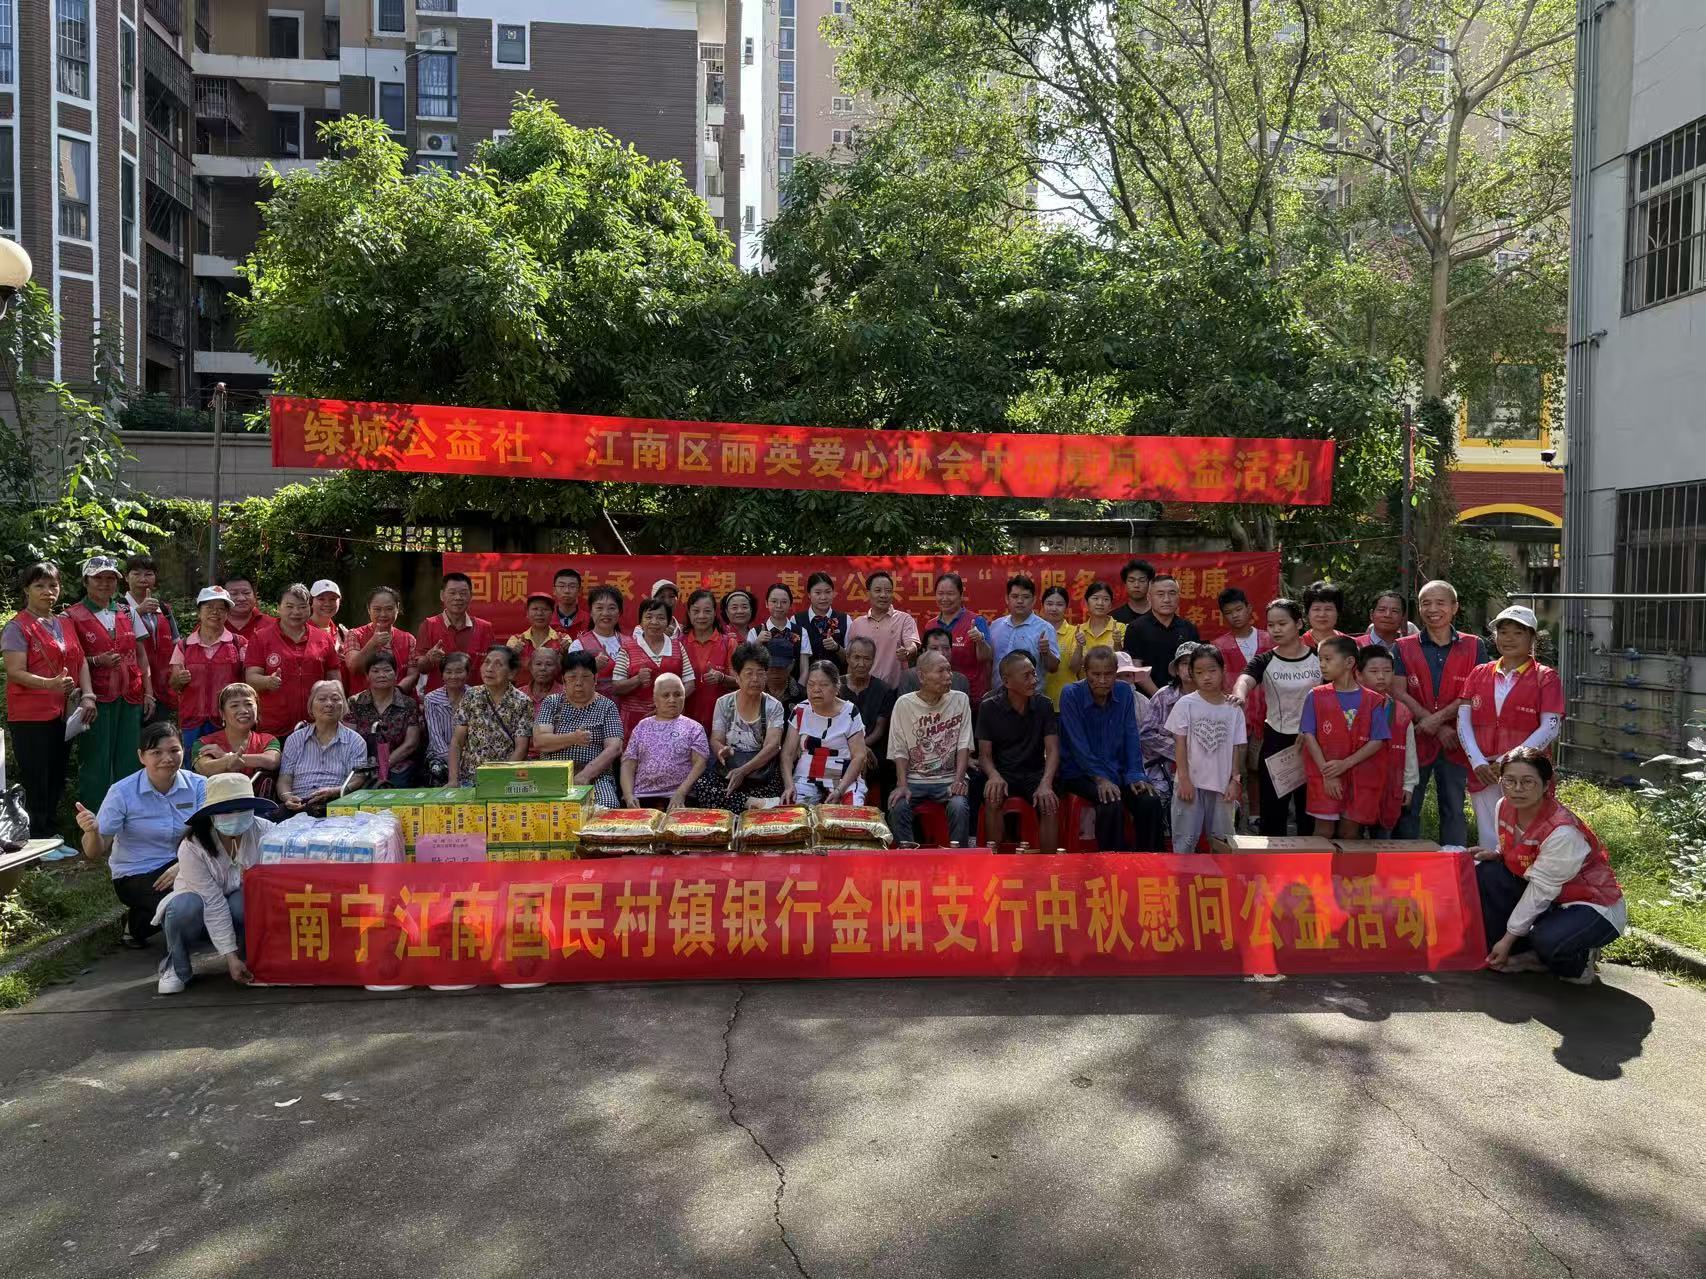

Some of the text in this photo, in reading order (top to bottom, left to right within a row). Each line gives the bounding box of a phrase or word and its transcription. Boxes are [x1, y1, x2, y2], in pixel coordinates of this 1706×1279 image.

[285, 874, 1440, 963] 南宁江南国民村镇银行金阳支行中秋慰问公益活动
